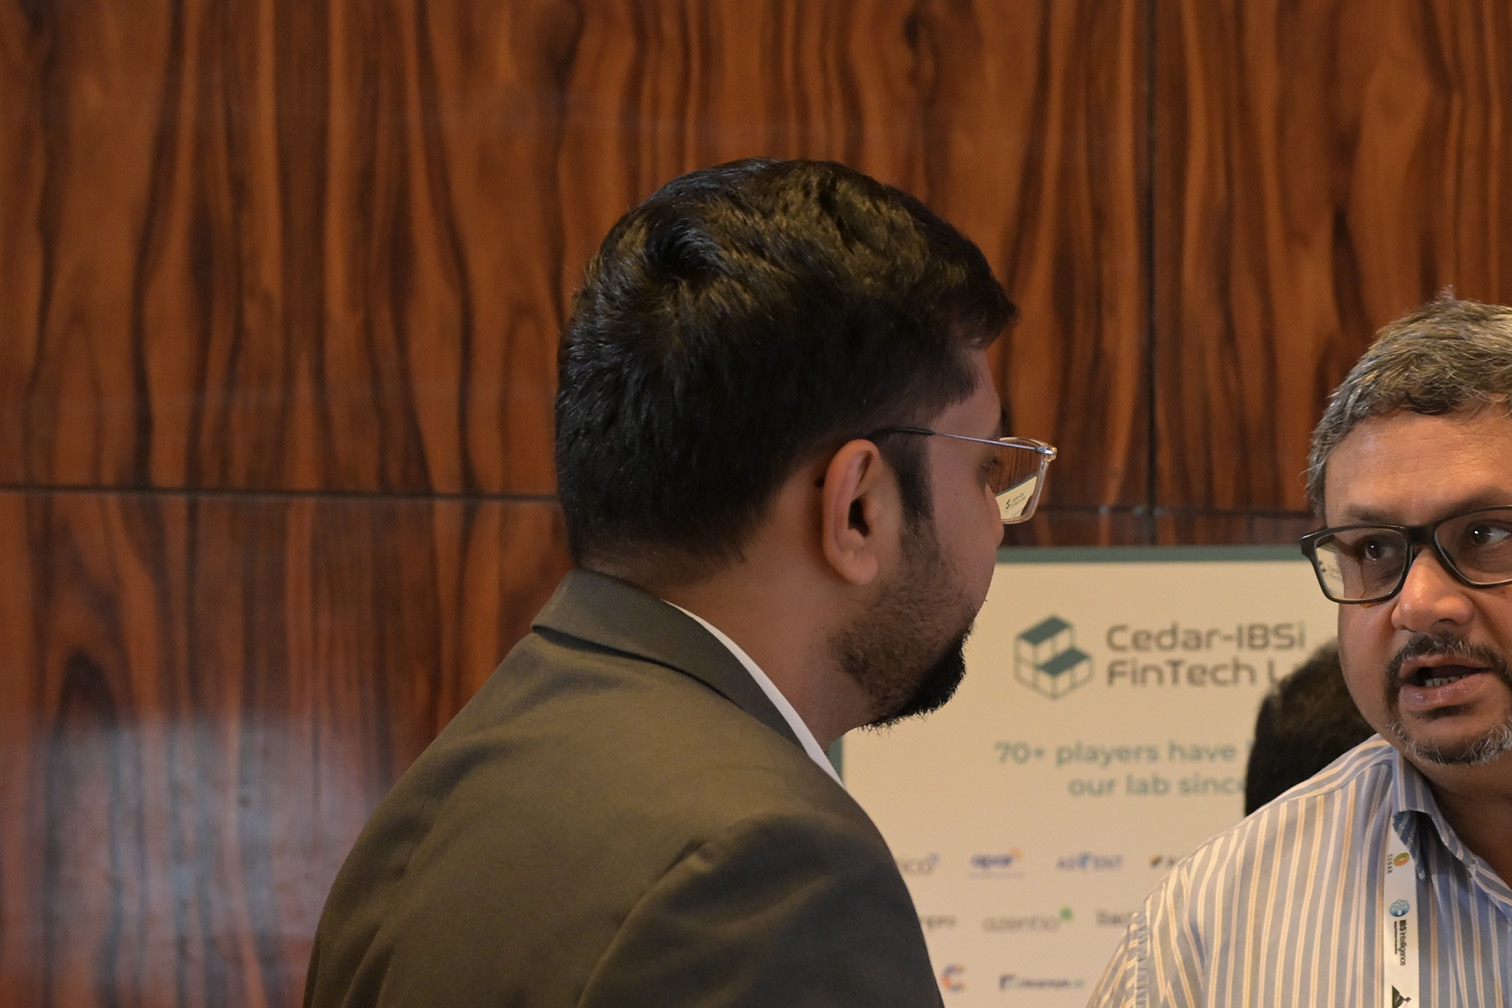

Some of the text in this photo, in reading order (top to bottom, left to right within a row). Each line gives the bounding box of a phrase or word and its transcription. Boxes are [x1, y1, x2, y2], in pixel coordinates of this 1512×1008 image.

[1105, 621, 1306, 652] Cedar-IBSi
[1106, 657, 1256, 687] FinTech
[995, 741, 1045, 764] 70+
[1056, 740, 1158, 767] players
[1168, 740, 1237, 763] have
[1068, 778, 1115, 797] our
[1126, 775, 1170, 796] lab
